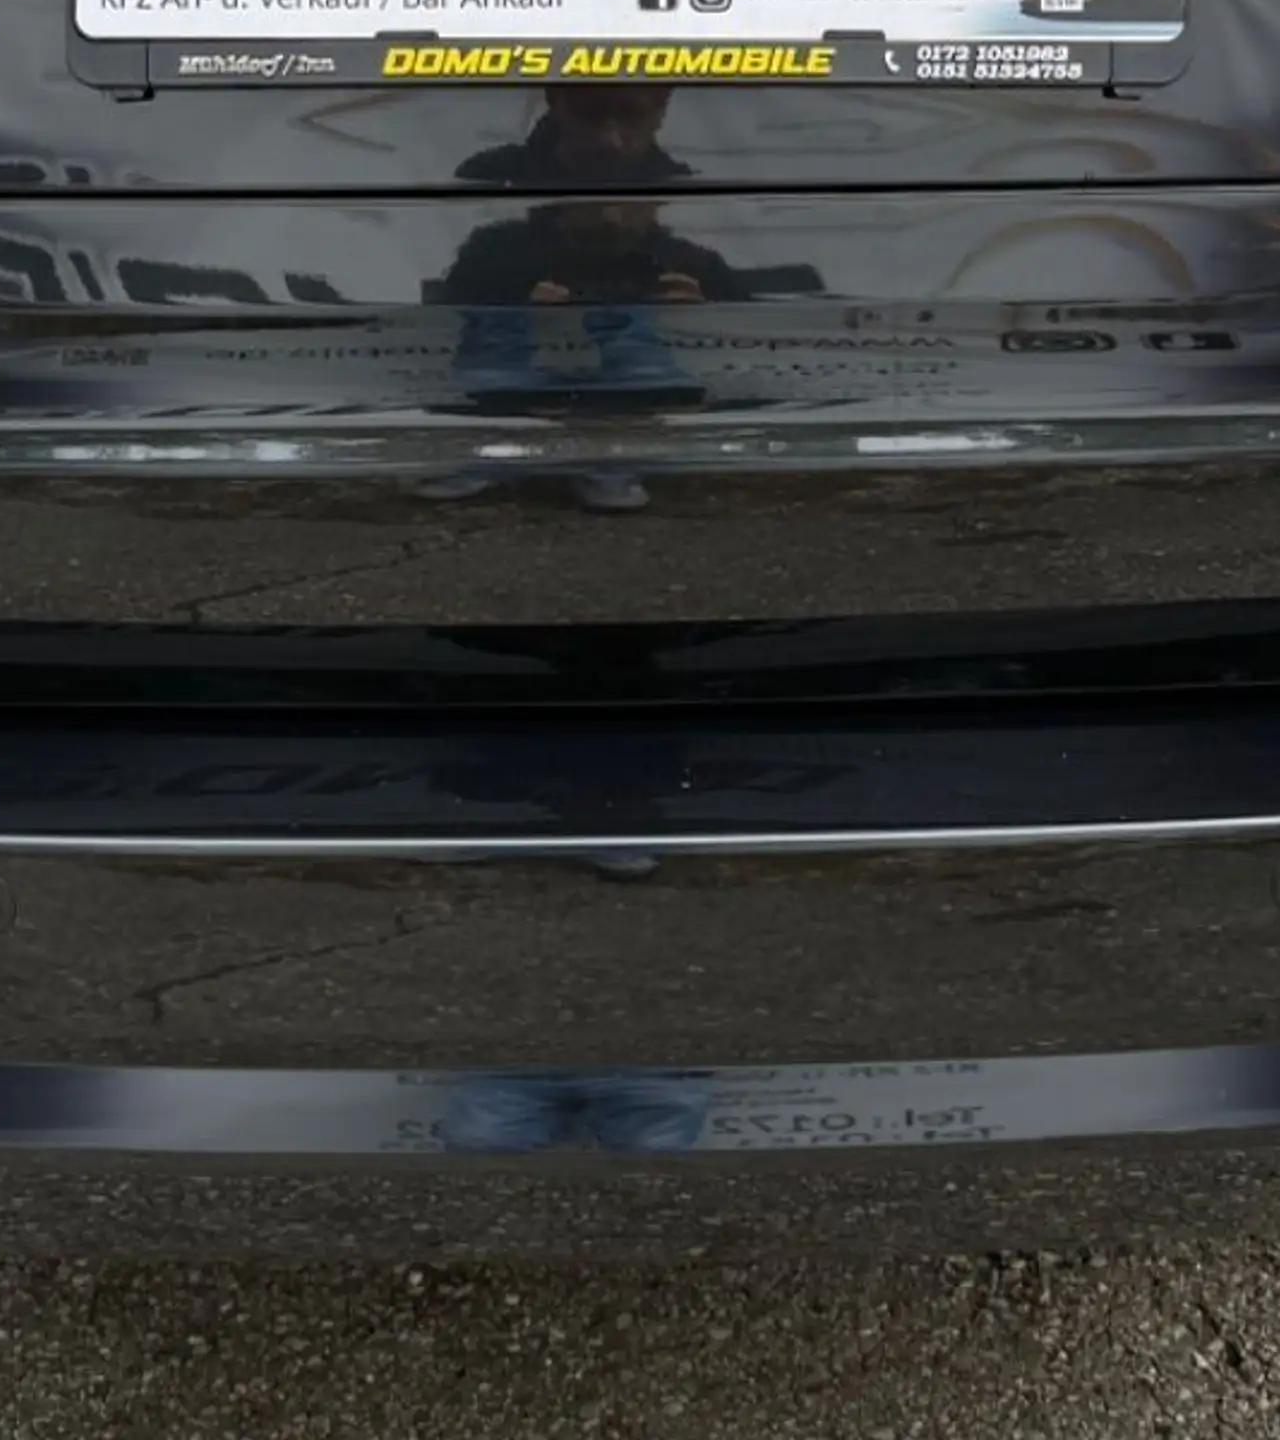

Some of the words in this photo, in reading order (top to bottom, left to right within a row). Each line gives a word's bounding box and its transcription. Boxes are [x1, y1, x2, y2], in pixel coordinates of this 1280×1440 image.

[382, 46, 551, 75] DOMO'S
[561, 47, 836, 75] AUTOMOBILE
[916, 45, 969, 61] 0172
[976, 45, 1069, 61] 1051982
[916, 63, 967, 79] 0151
[974, 63, 1083, 79] 51324755
